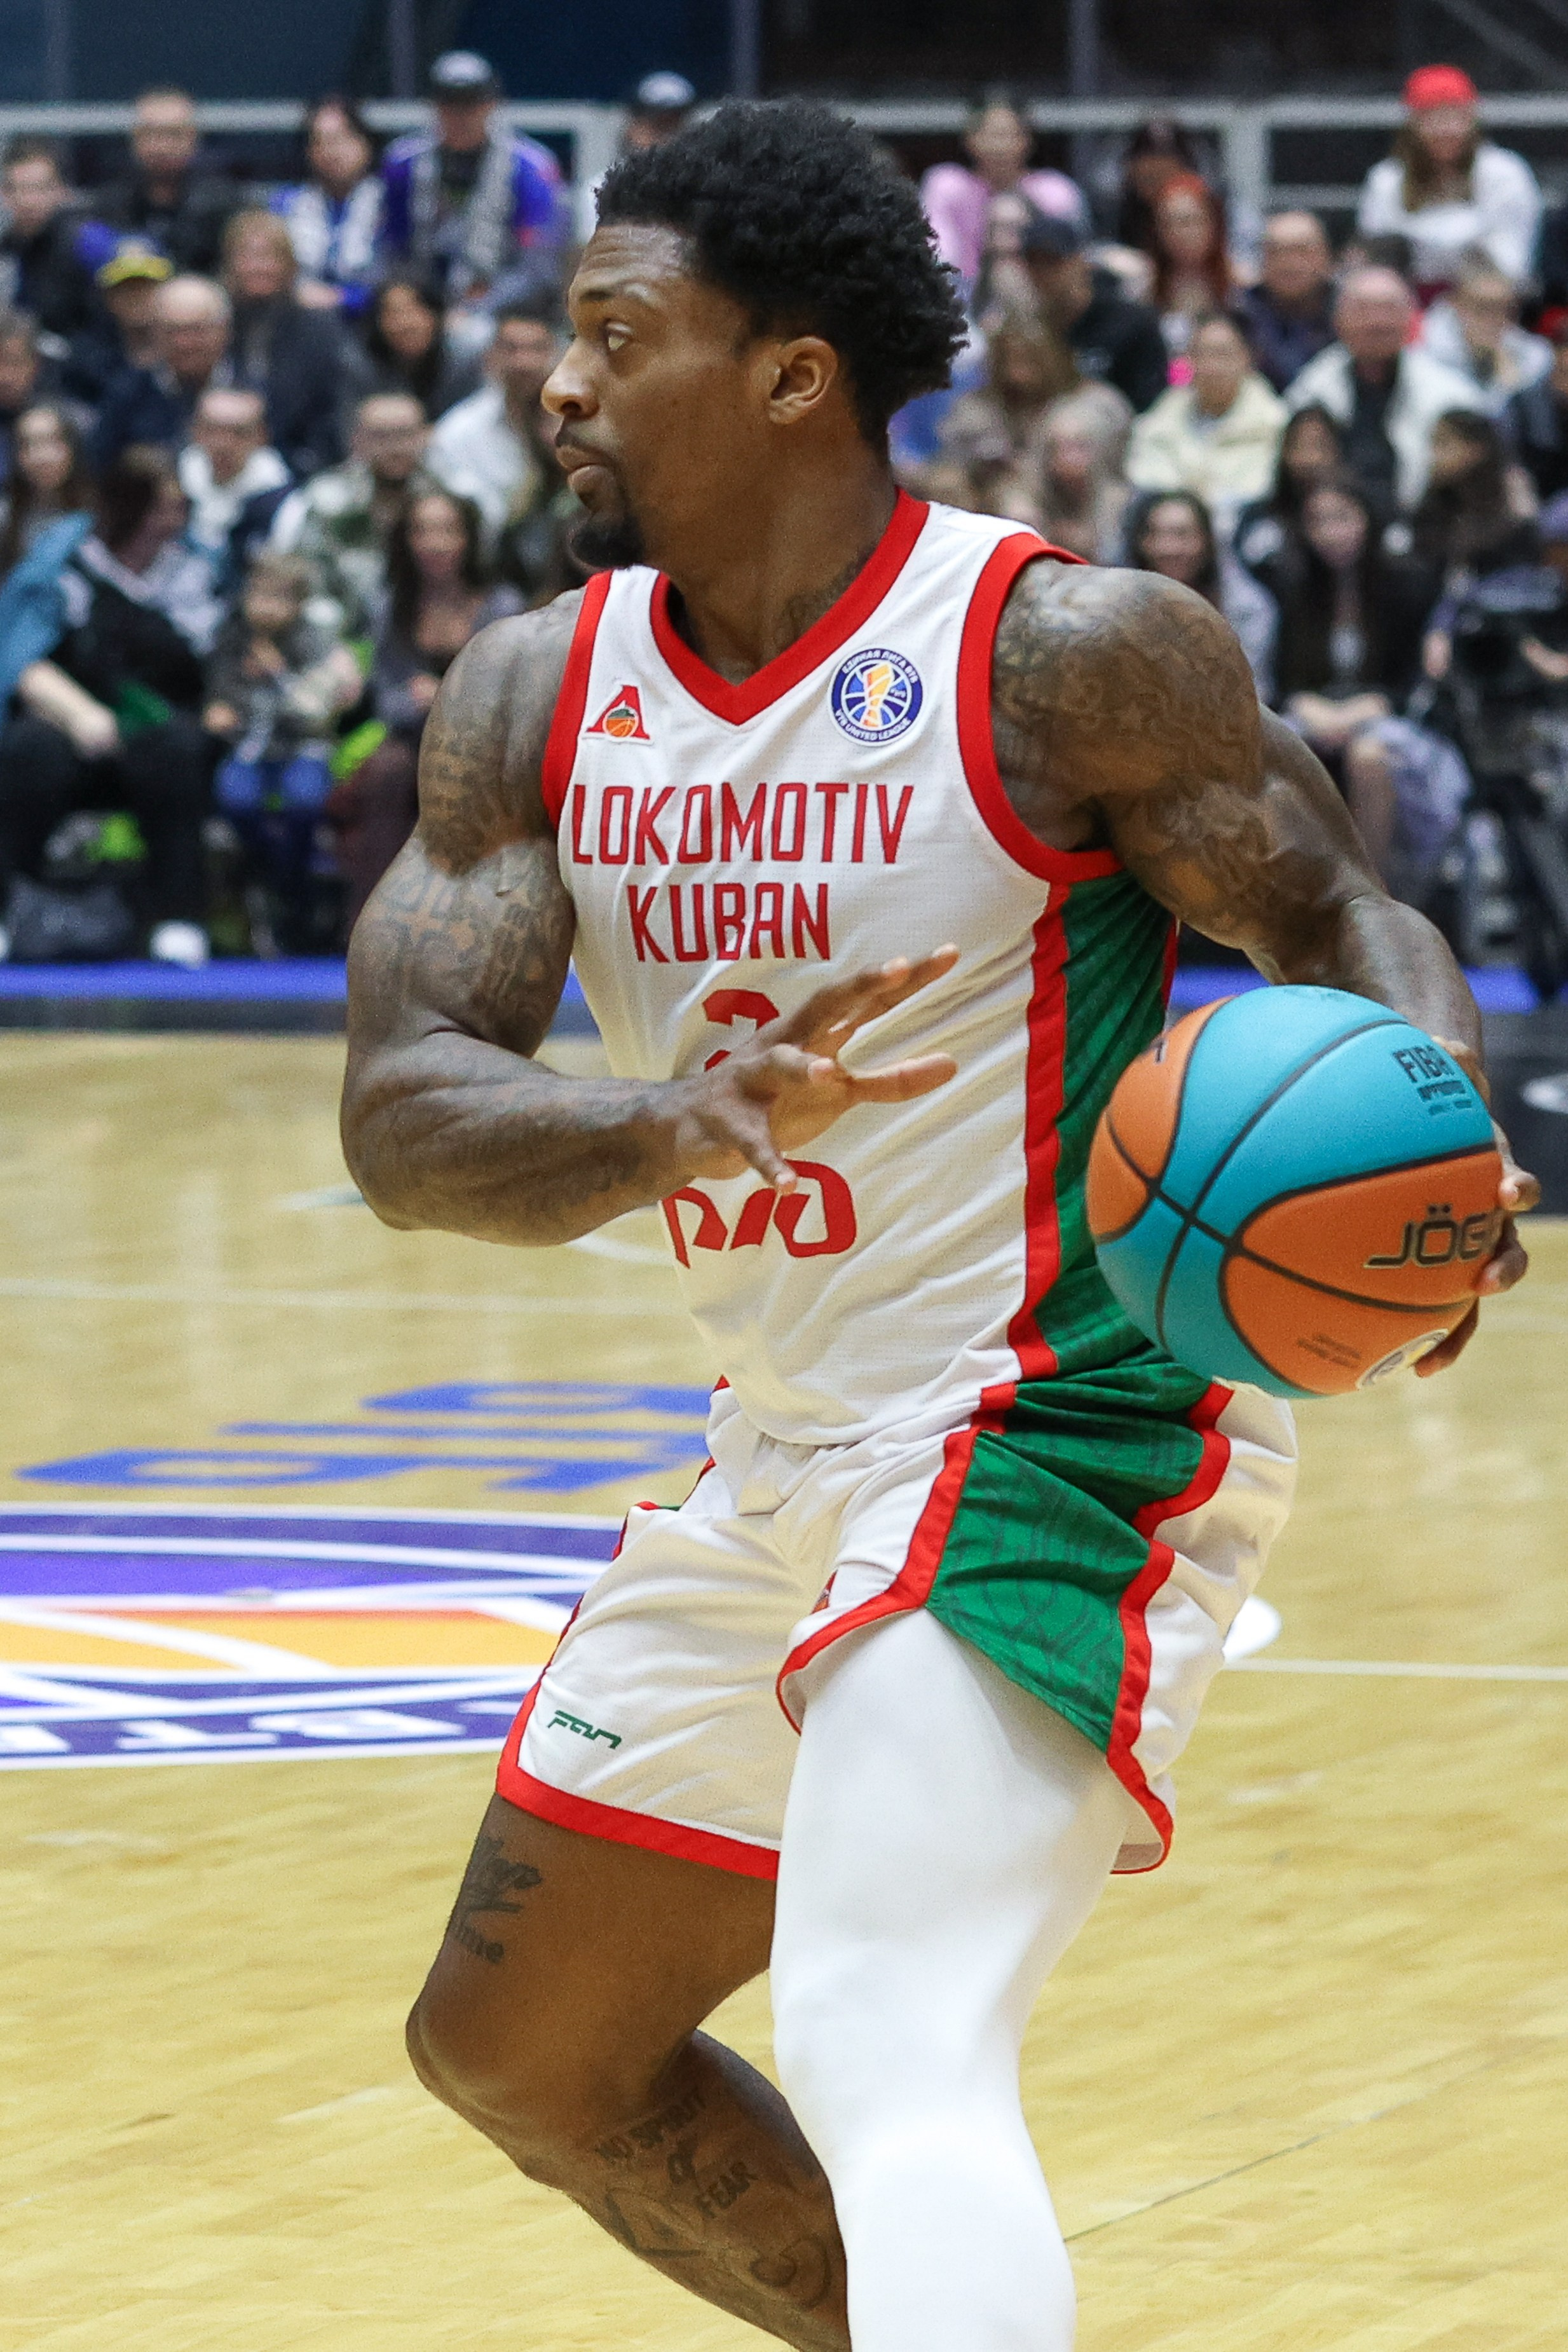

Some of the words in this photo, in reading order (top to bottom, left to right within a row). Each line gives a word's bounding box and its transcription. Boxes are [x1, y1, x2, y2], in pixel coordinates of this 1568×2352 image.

[845, 724, 878, 741] UNITED
[572, 782, 915, 865] LOKOMOTIV
[627, 882, 831, 964] KUBAN
[694, 2161, 759, 2219] FEAR
